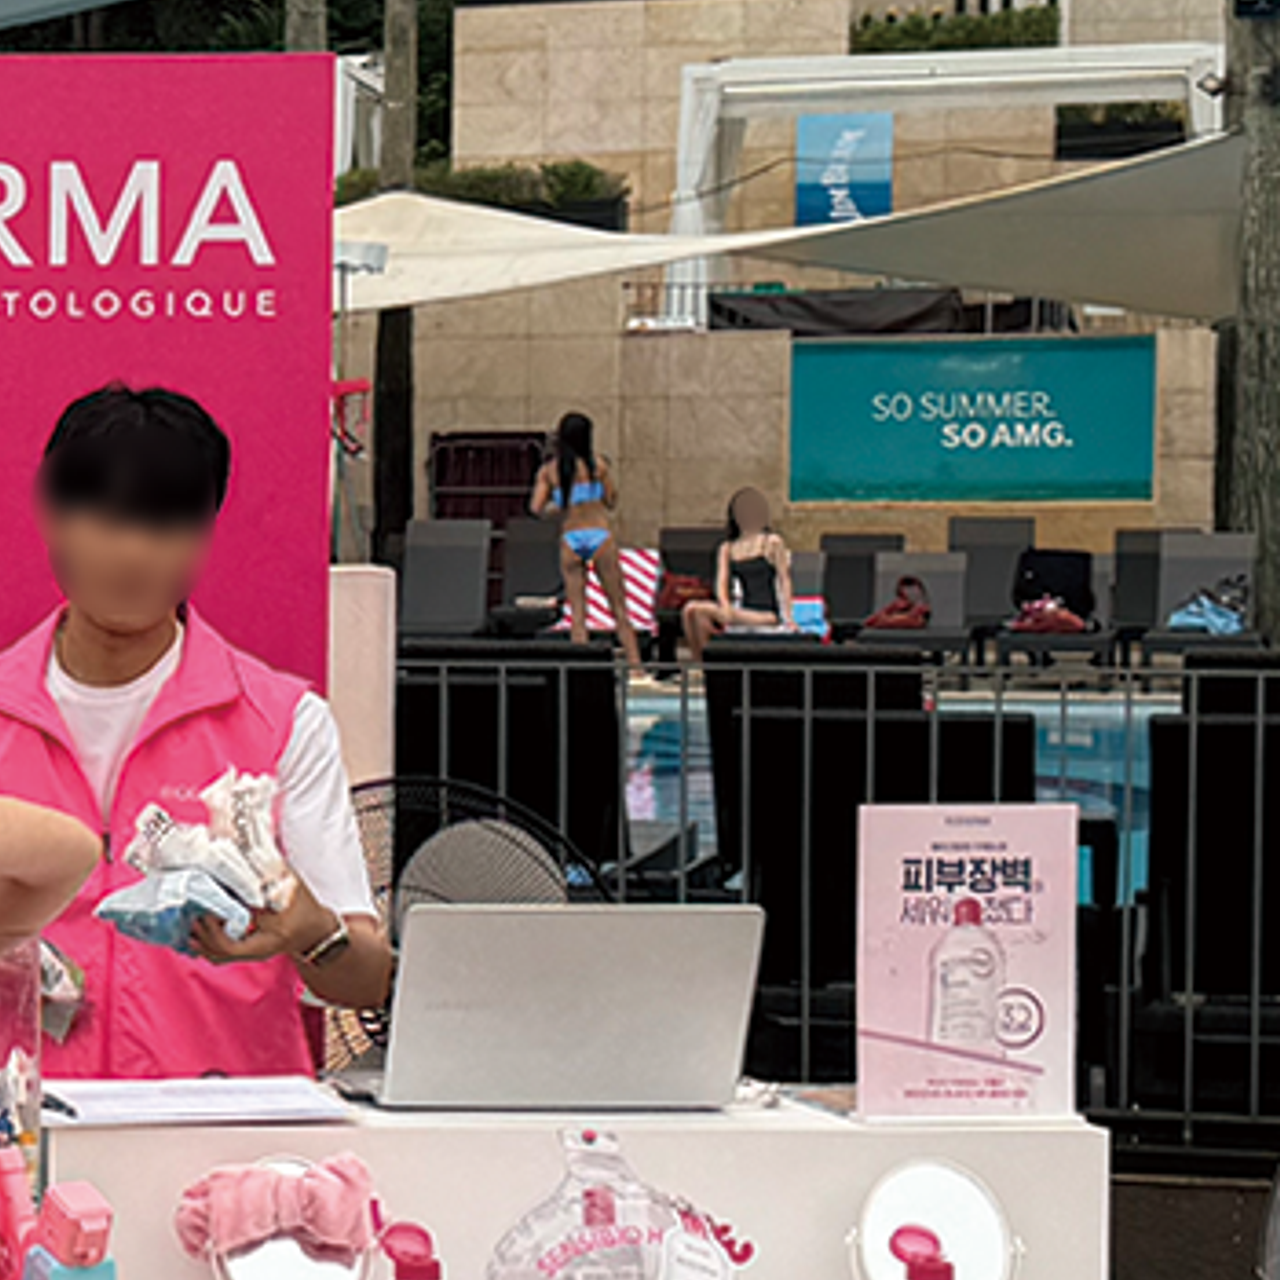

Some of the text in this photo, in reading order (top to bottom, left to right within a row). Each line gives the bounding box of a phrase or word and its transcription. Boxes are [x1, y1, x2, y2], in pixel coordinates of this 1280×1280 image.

[872, 391, 1056, 420] SO SUMMER.
[941, 422, 1074, 448] SO AMG.
[902, 857, 1033, 894] 피부장벽
